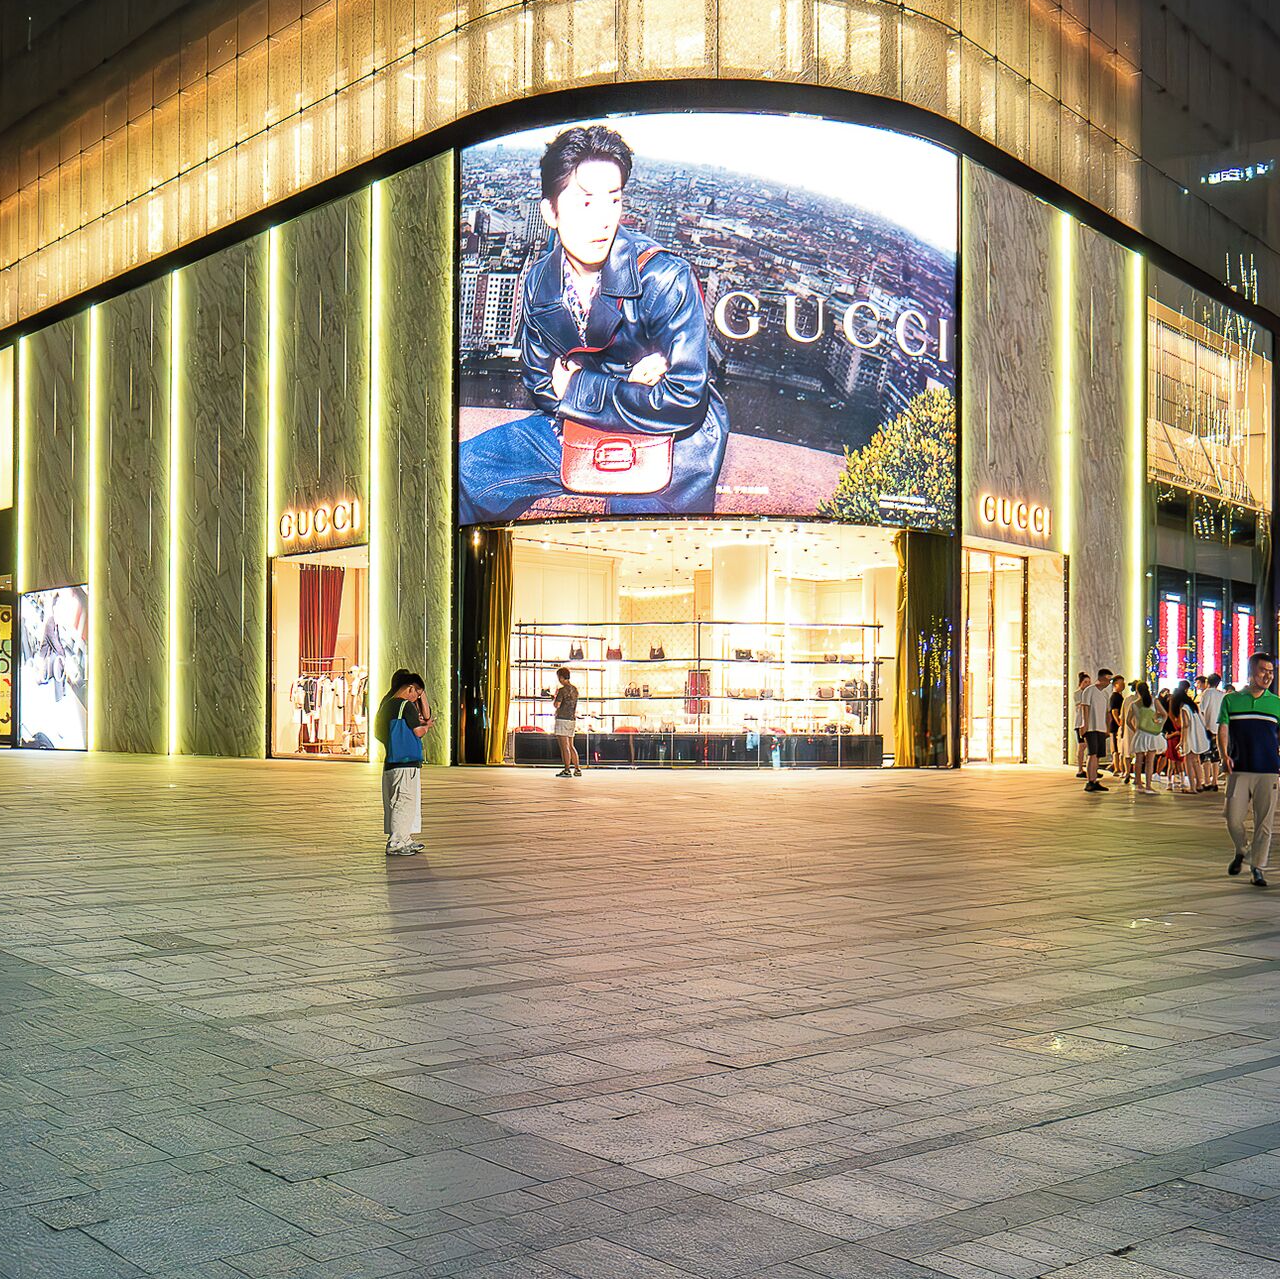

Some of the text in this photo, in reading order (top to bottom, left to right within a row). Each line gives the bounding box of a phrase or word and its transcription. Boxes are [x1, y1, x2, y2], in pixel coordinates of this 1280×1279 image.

[714, 290, 950, 363] GUCCI
[279, 502, 355, 539] GUCCI
[984, 495, 1053, 536] GUCCI
